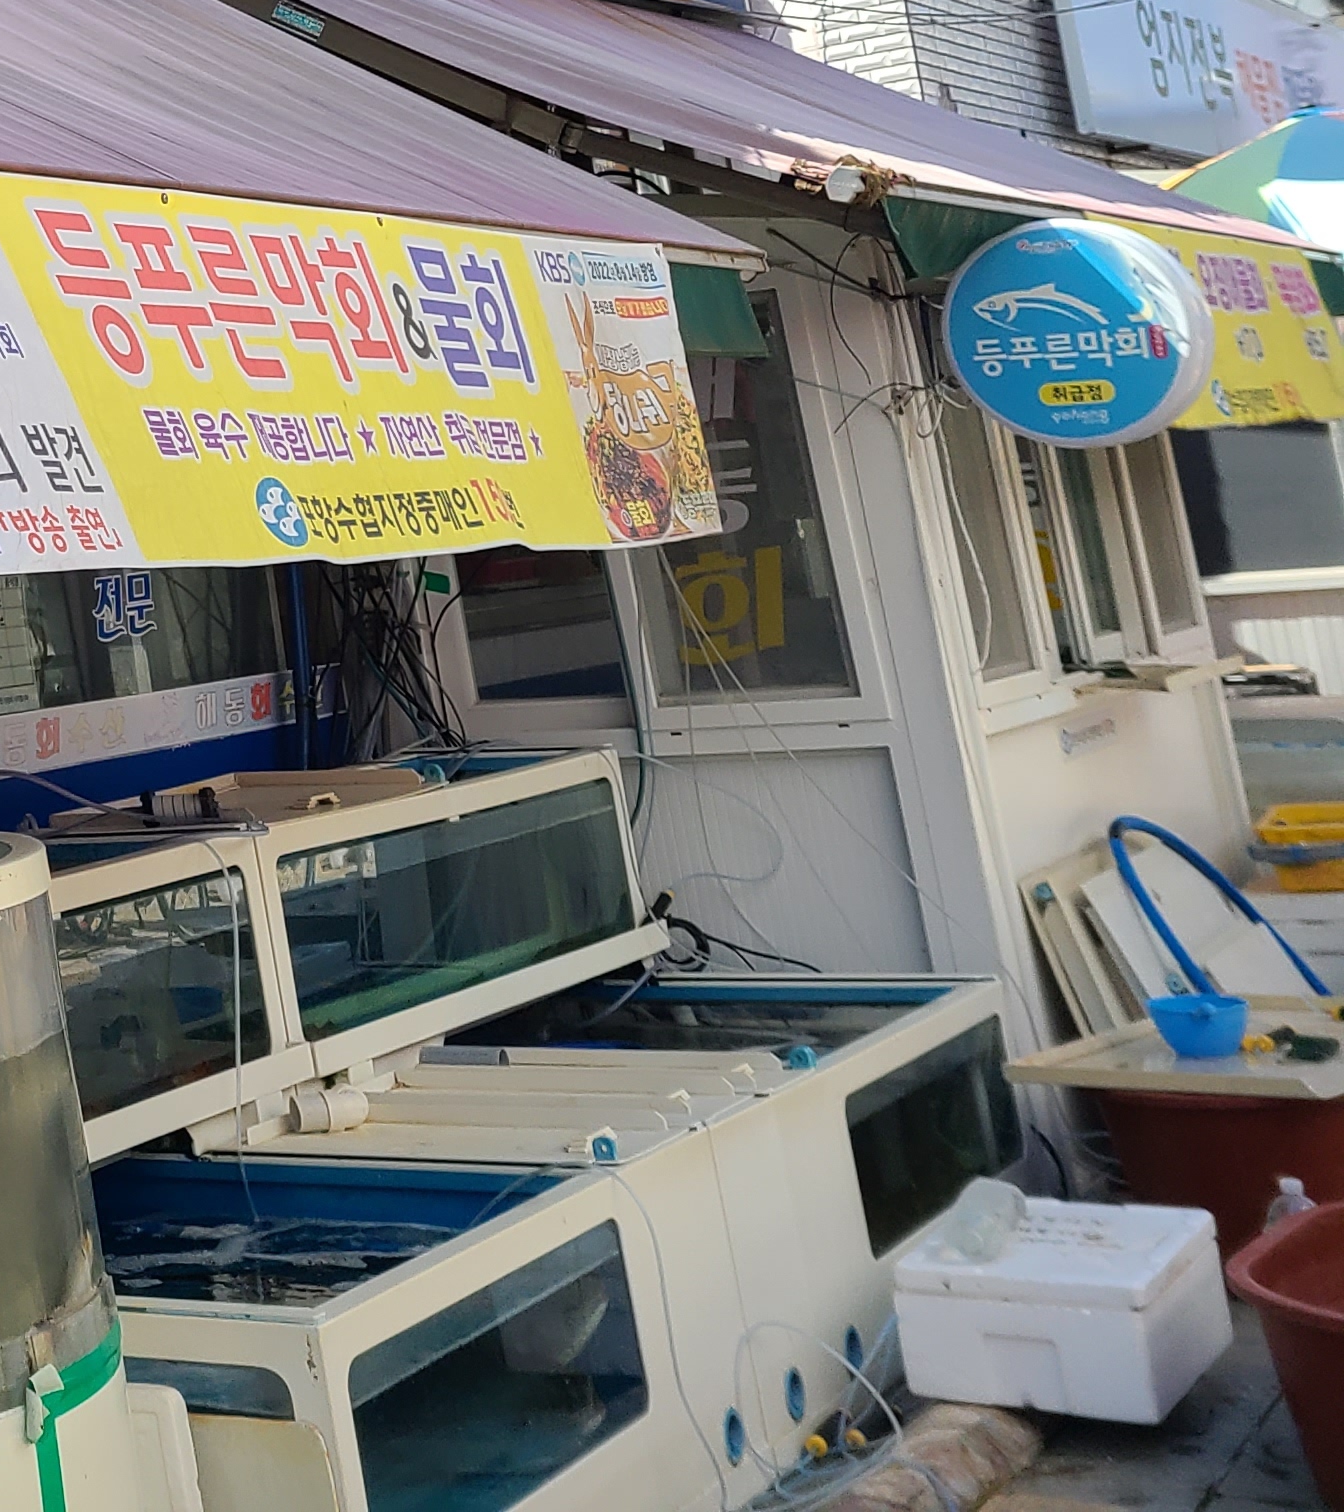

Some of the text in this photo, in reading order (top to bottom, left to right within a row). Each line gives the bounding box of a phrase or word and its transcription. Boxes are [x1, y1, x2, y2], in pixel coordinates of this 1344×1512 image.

[534, 249, 571, 284] KBS
[973, 326, 1150, 378] 등푸른막회
[1051, 384, 1103, 402] 취급점
[20, 422, 106, 495] 발견
[143, 408, 201, 461] 물회
[193, 411, 250, 463] 육수
[379, 414, 445, 460] 자연산
[92, 570, 157, 643] 전문
